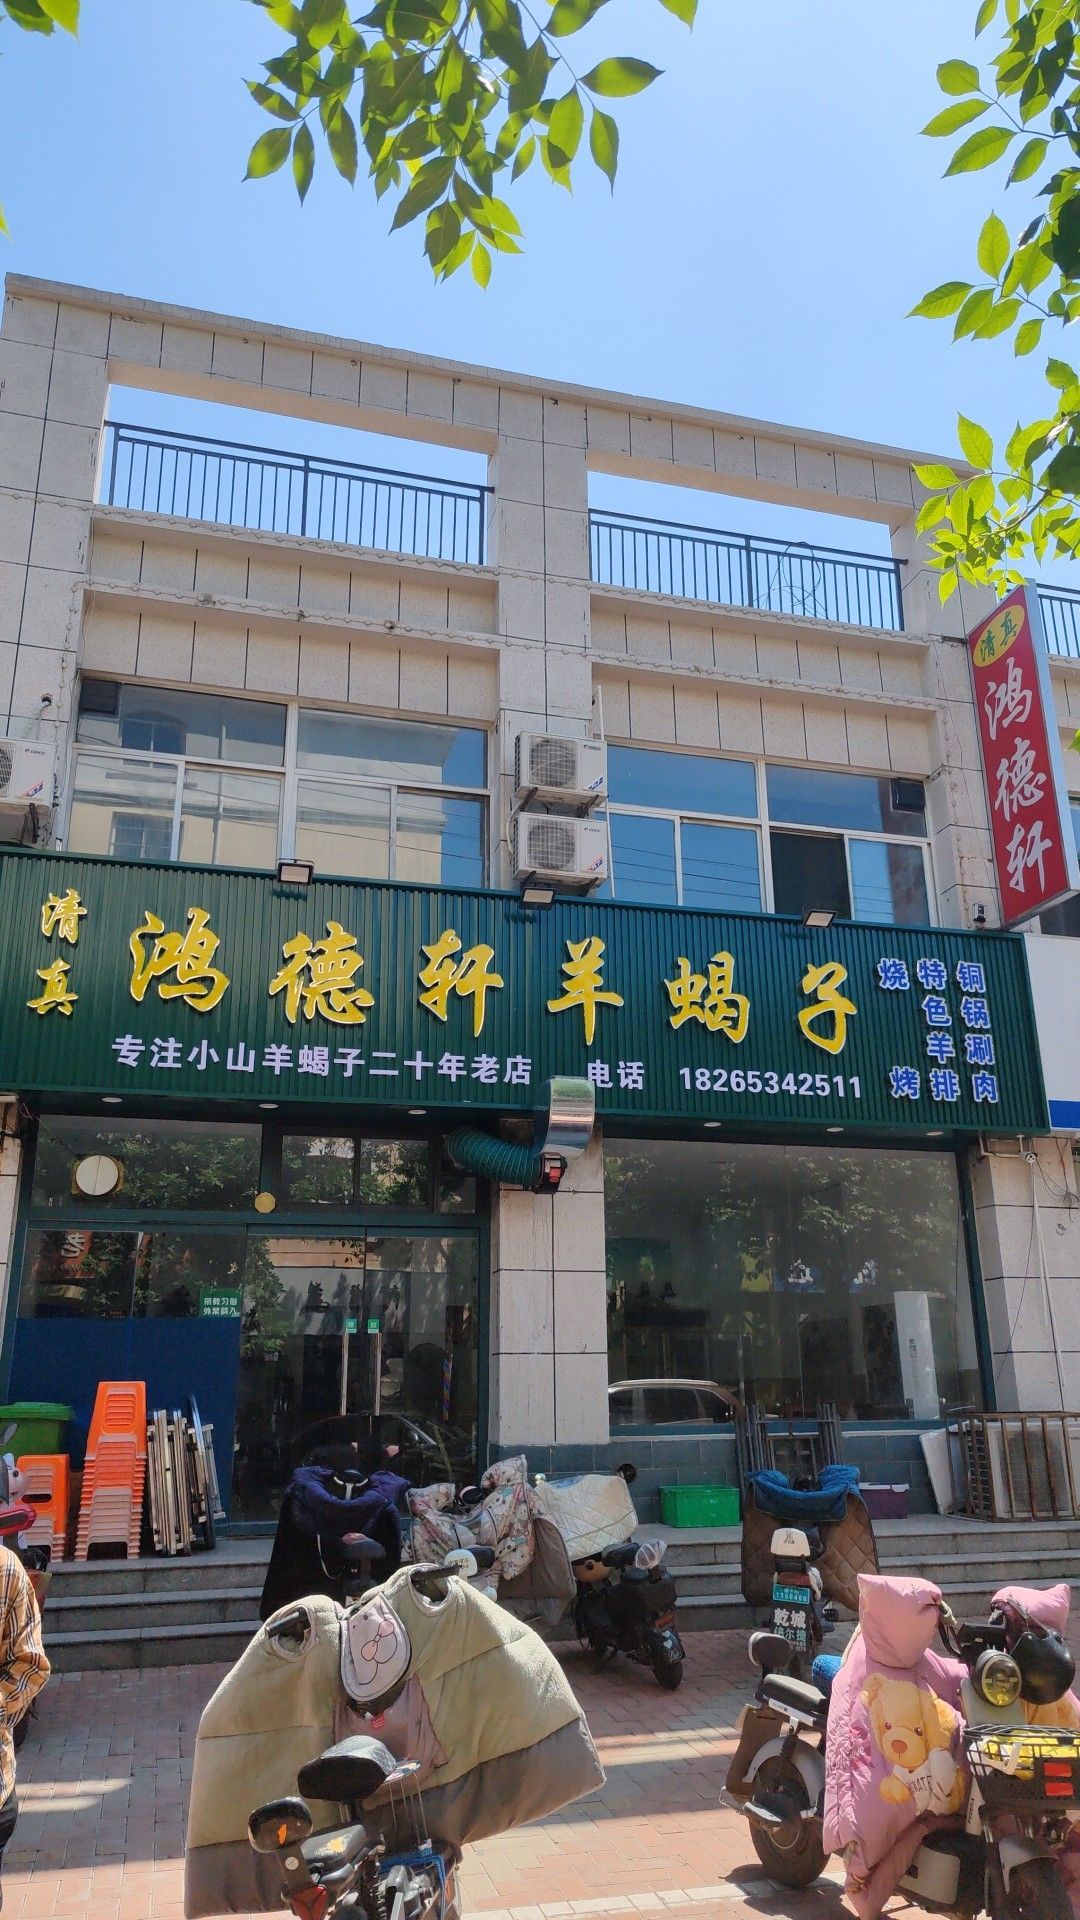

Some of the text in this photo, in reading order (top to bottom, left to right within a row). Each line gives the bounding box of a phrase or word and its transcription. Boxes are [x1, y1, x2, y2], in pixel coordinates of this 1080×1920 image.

[979, 611, 1018, 662] 清真
[984, 656, 1052, 894] 鸿德轩
[26, 888, 88, 1016] 清真
[111, 1034, 533, 1085] 专注小山羊蝎子二十年老店
[679, 1066, 862, 1099] 18265342511
[916, 957, 961, 1102] 特色羊排
[956, 961, 999, 1103] 铜锅涮肉
